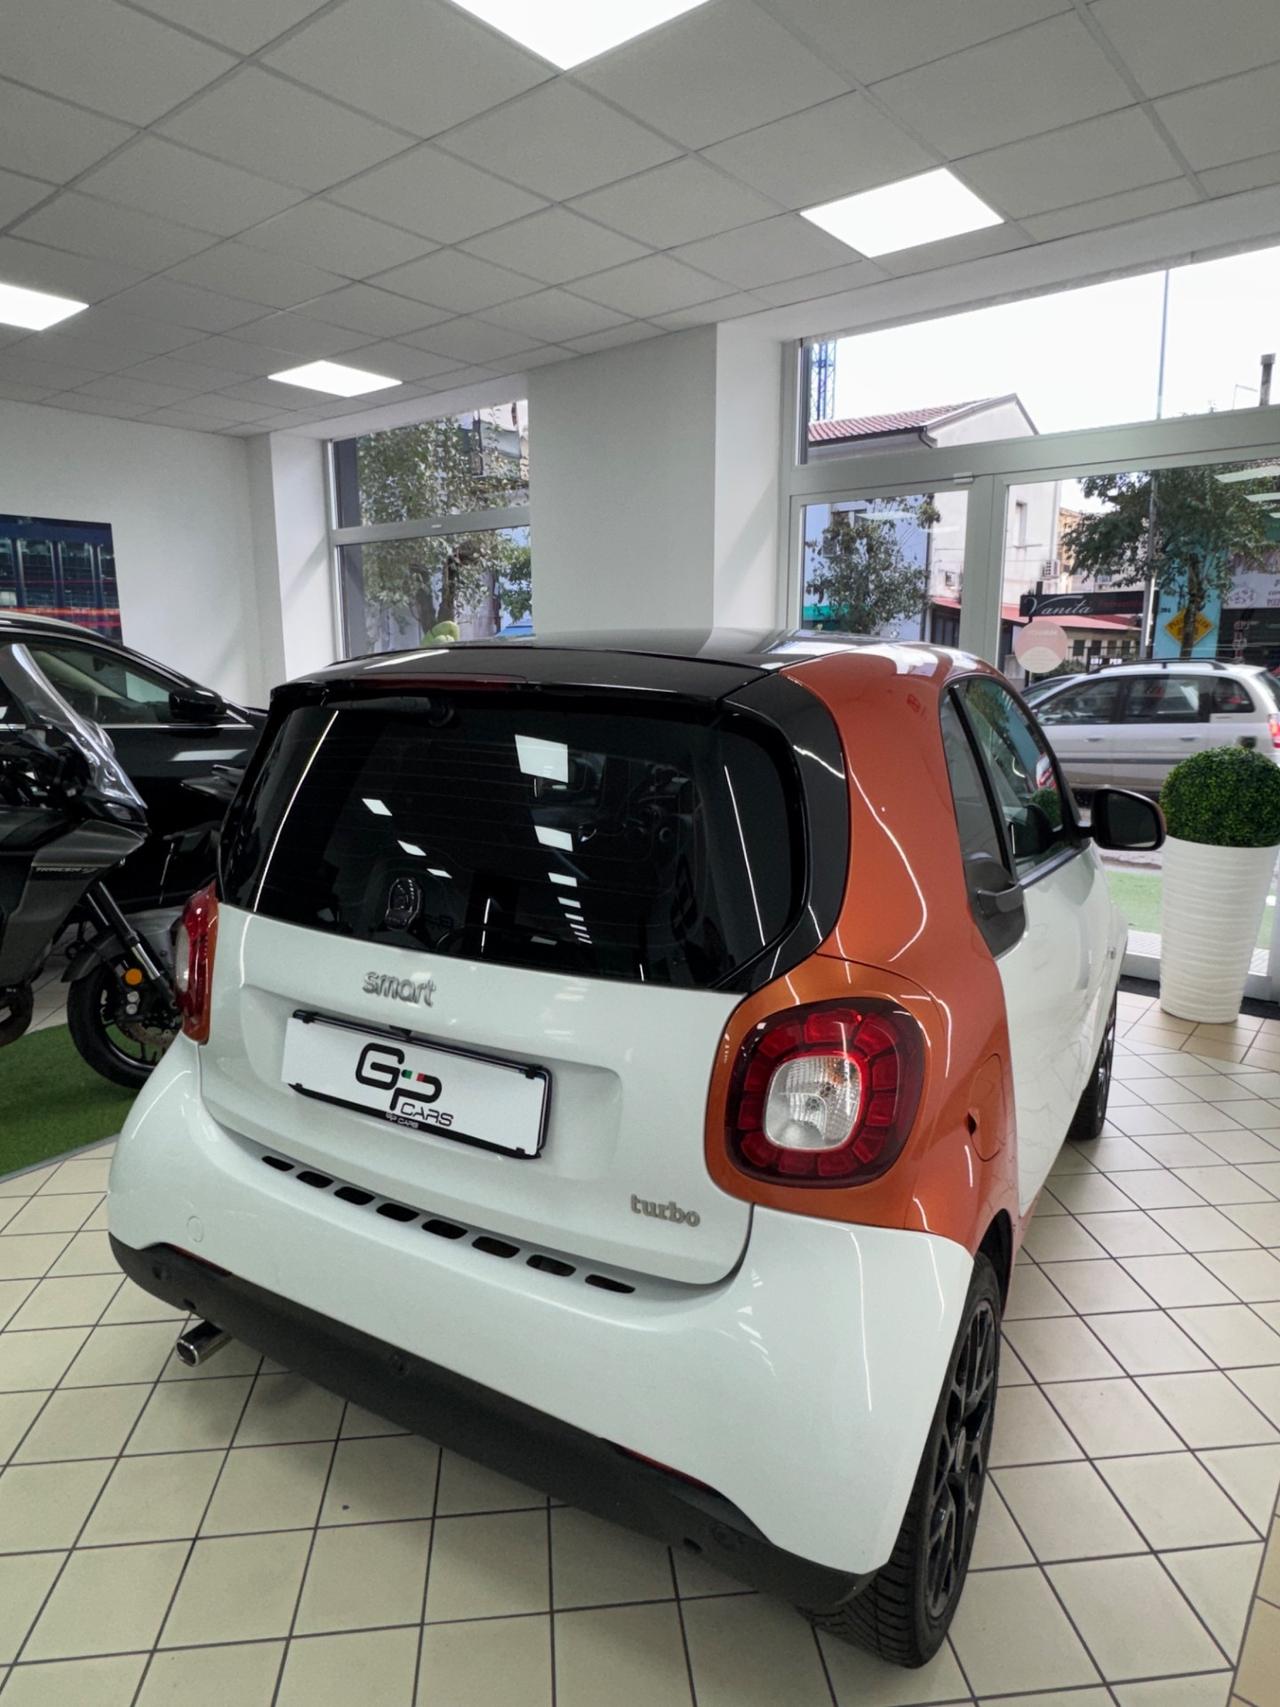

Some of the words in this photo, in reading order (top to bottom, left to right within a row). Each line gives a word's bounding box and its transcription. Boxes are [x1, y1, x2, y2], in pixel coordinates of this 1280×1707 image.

[362, 971, 437, 1008] smart
[355, 1042, 443, 1112] GP
[400, 1102, 455, 1128] CARS
[631, 1193, 701, 1228] turbo
